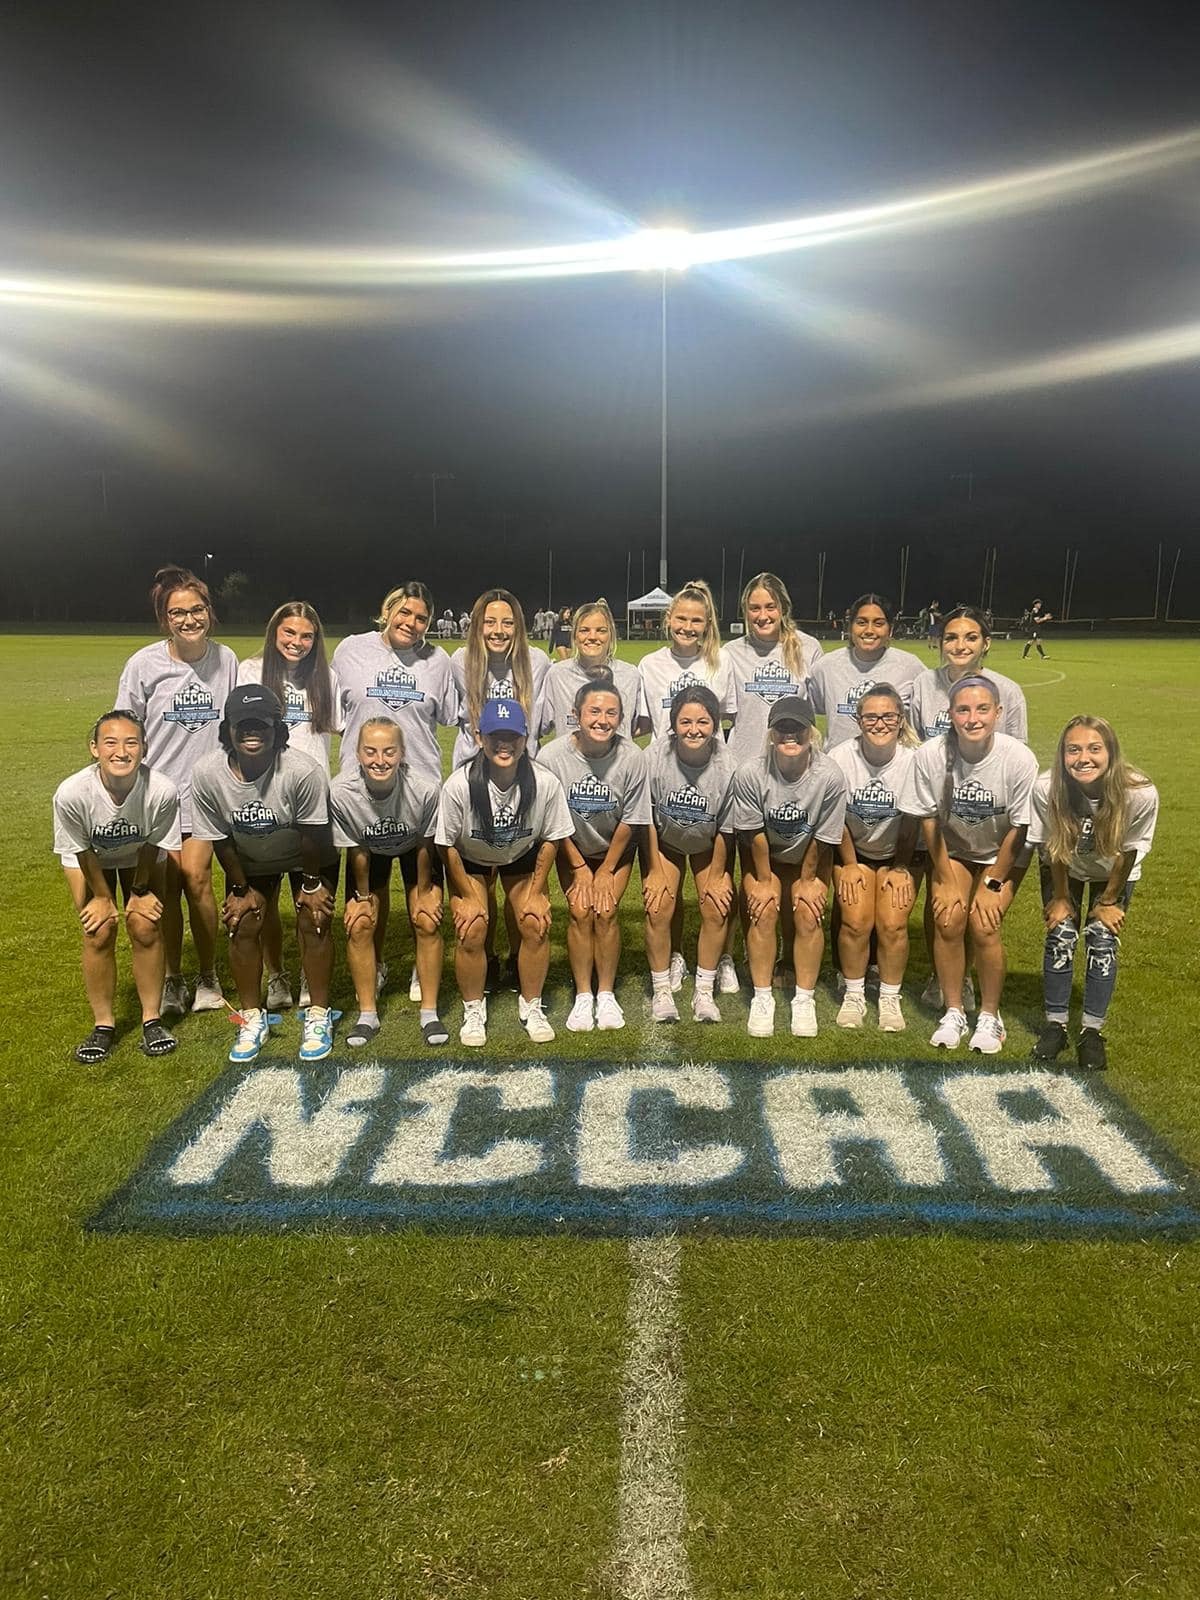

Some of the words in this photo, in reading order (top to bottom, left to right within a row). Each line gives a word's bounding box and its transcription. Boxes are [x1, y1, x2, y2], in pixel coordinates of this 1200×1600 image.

[378, 671, 415, 685] NCCAA
[755, 667, 790, 679] NCCAA
[175, 693, 212, 705] NCCAA
[497, 703, 511, 719] LA
[571, 783, 609, 796] NCCAA
[855, 790, 893, 803] NCCAA
[952, 788, 992, 802] NCCAA
[669, 791, 706, 807] NCCAA
[232, 808, 274, 822] NCCAA
[769, 809, 806, 821] NCCAA
[94, 824, 139, 838] NCCAA
[366, 822, 405, 836] NCCAA
[165, 1064, 1170, 1193] NCCAA
